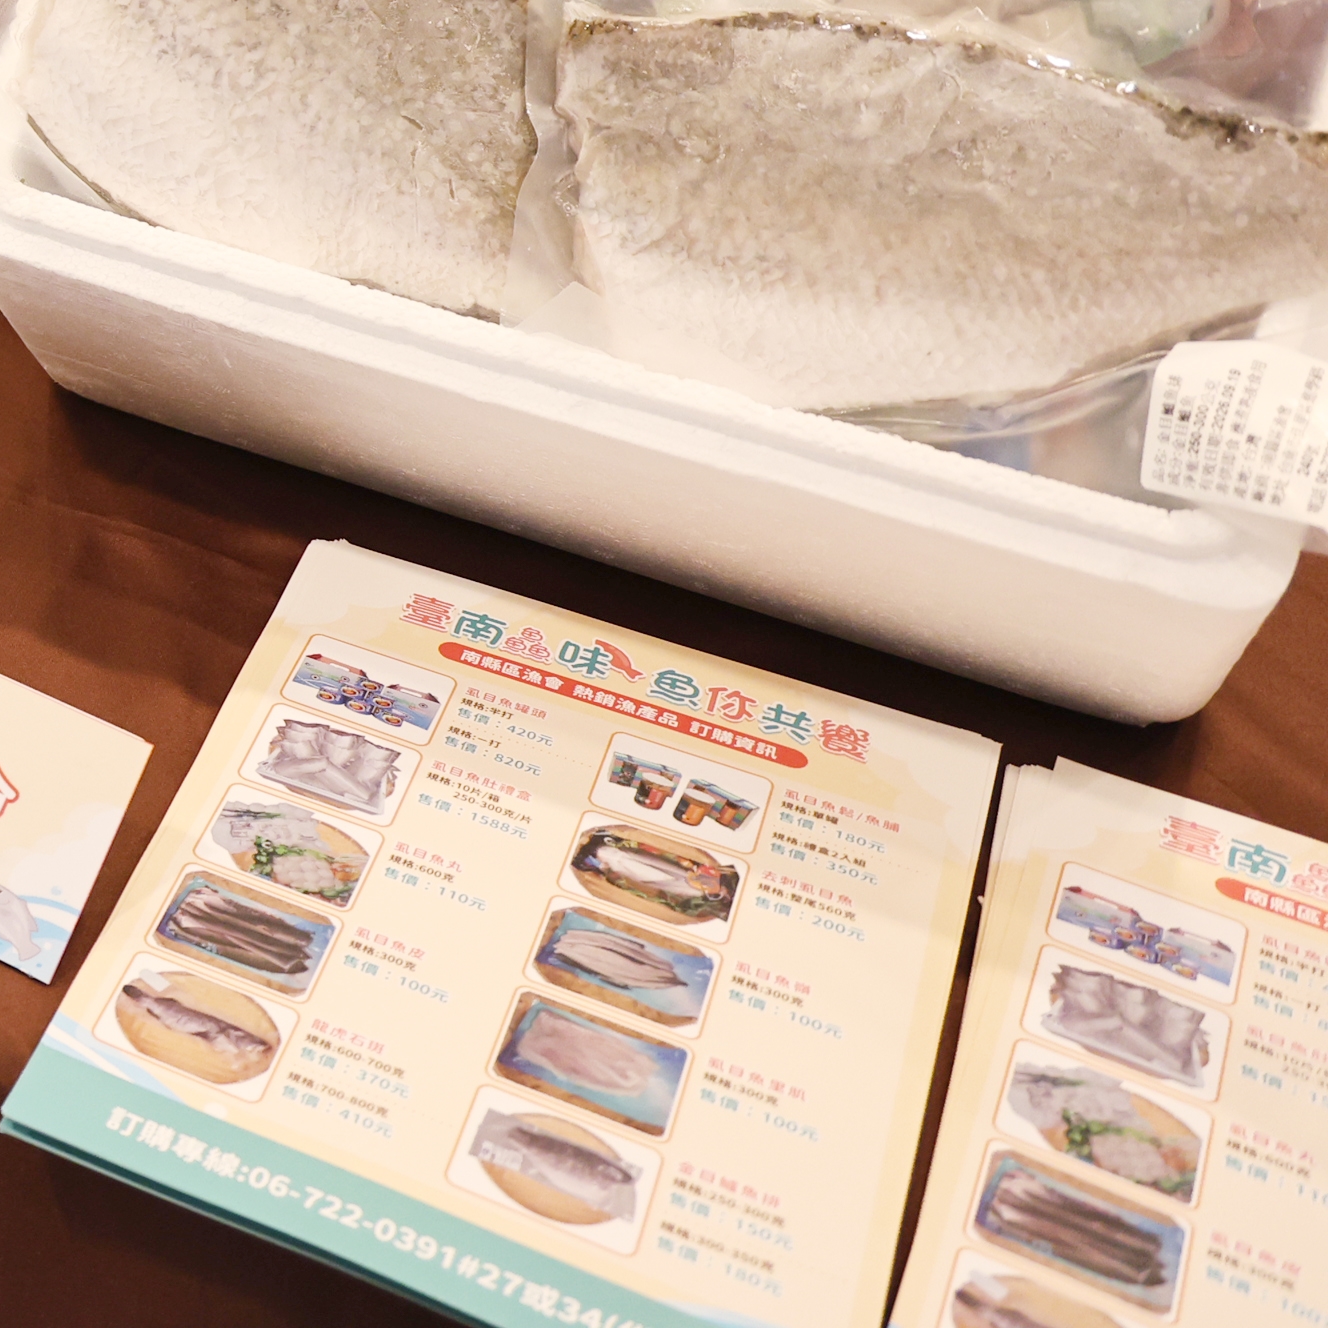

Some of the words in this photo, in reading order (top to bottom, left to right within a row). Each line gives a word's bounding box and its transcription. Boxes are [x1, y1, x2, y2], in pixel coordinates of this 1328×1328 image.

[399, 593, 614, 678] 臺南鱻味
[646, 668, 871, 763] 魚你共饗
[460, 648, 565, 690] 南縣區漁會
[571, 682, 679, 728] 熱銷漁產品
[690, 720, 779, 761] 訂購資訊
[431, 760, 534, 803] 虱目魚肚禮盒
[452, 791, 534, 825] 250-300克/片
[394, 841, 463, 874] 虱目魚丸
[761, 870, 855, 908] 去刺虱目魚
[1244, 886, 1328, 931] 南縣區
[353, 927, 427, 961] 虱目魚皮
[310, 1017, 387, 1056] 龍虎石斑
